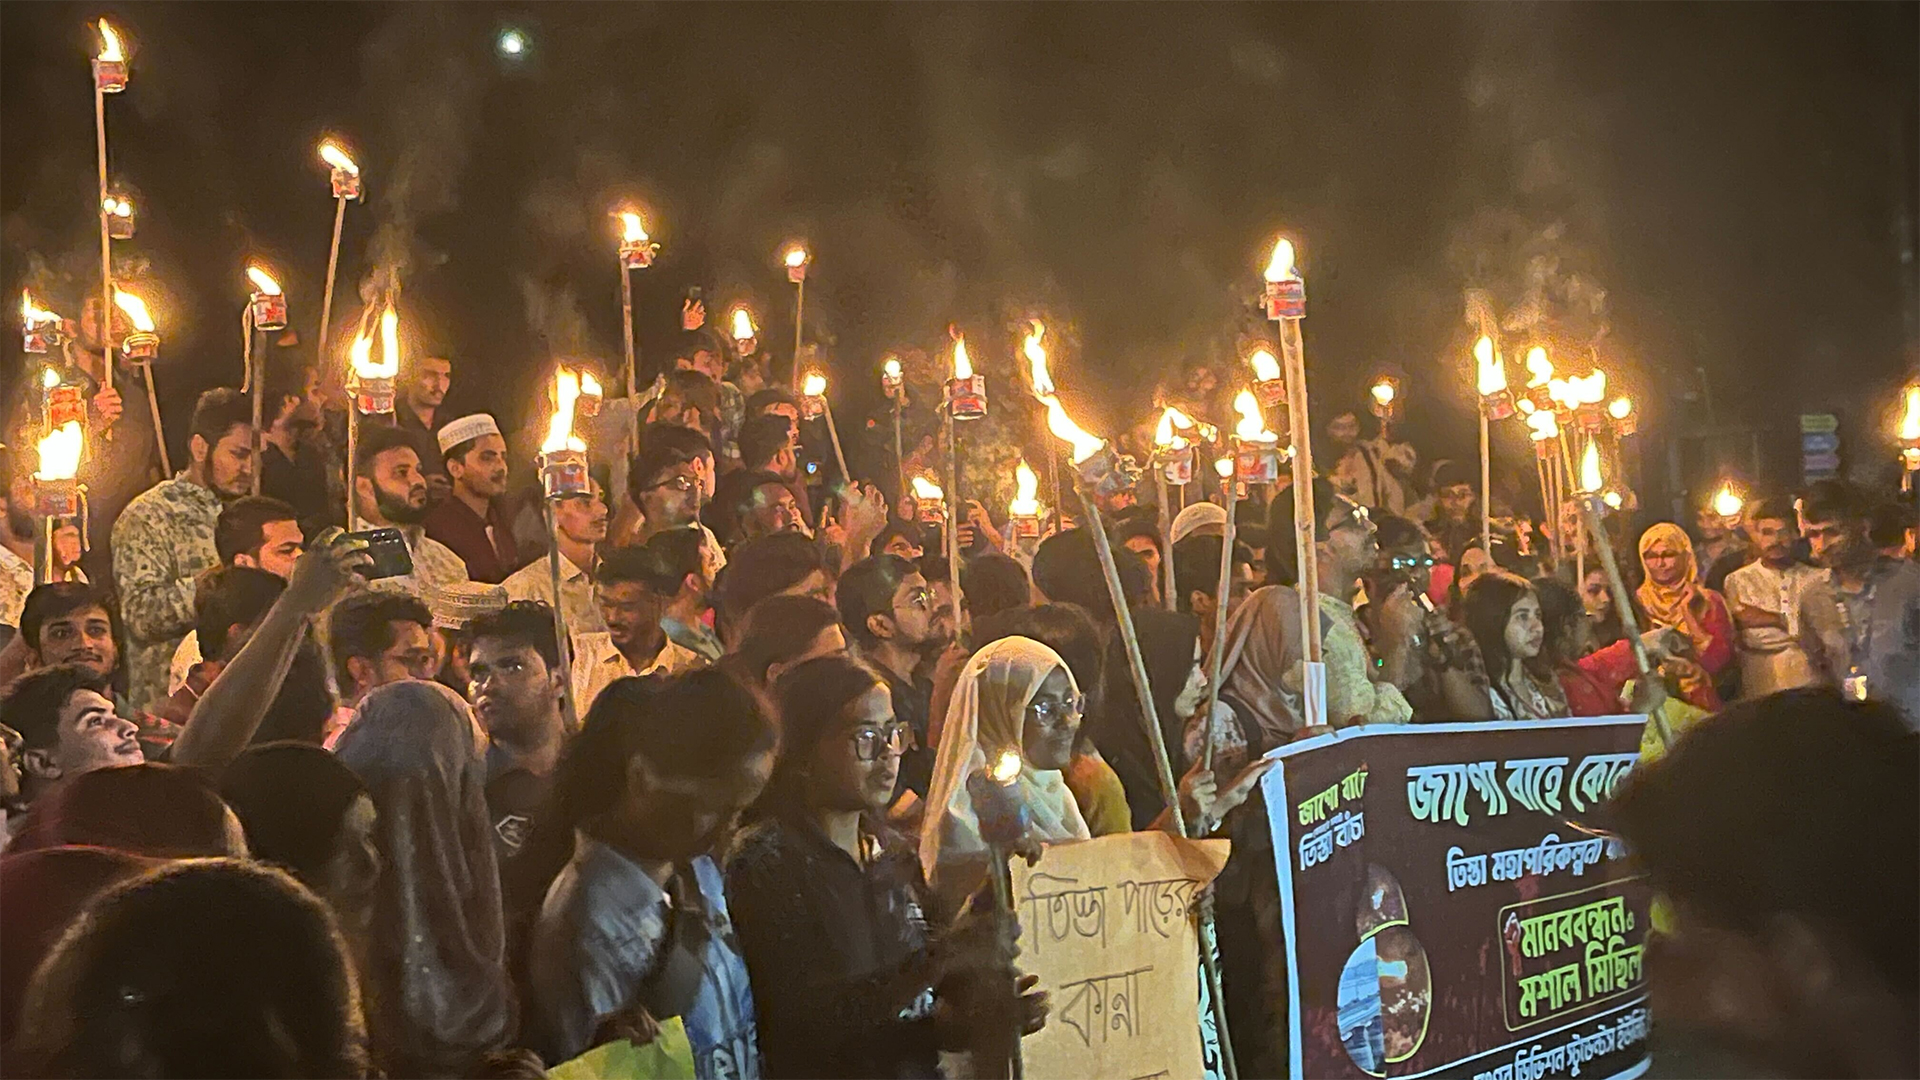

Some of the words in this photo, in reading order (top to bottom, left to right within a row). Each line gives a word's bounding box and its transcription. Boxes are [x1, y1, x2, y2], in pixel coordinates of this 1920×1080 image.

[1297, 783, 1339, 826] জাগো
[1406, 760, 1508, 827] জাগো
[1504, 757, 1570, 816] বাহে
[1299, 830, 1334, 871] তিস্তা
[1446, 845, 1488, 892] তিস্তা
[1491, 834, 1603, 882] মহাপরিকল্পনা
[1520, 896, 1625, 958] মানববন্ধন
[1059, 965, 1154, 1047] কান্না
[1518, 963, 1582, 1017] মশাল
[1585, 935, 1643, 998] মিছিল
